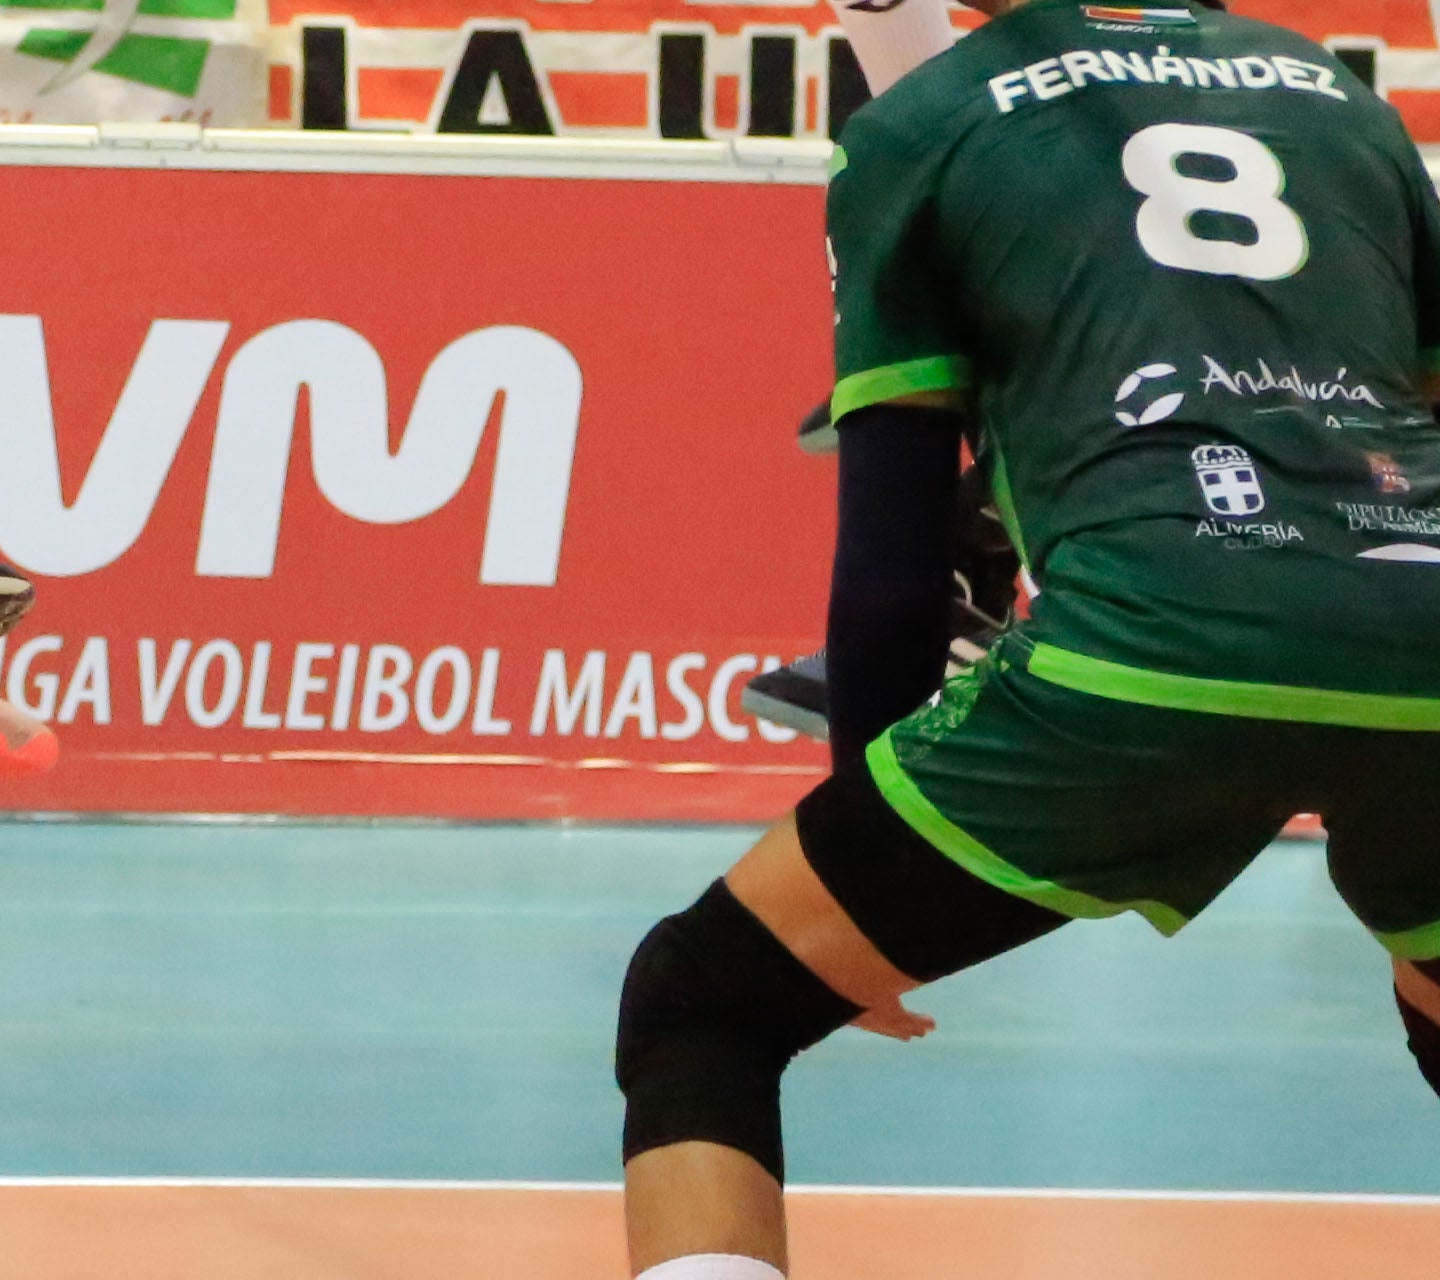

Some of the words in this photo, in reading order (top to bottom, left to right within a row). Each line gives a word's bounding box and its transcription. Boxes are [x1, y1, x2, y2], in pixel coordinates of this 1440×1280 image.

[987, 45, 1349, 114] FERNÁNDEZ
[1121, 122, 1310, 282] 8
[1199, 354, 1385, 409] Andalucía
[136, 637, 513, 737] VOLEIBOL
